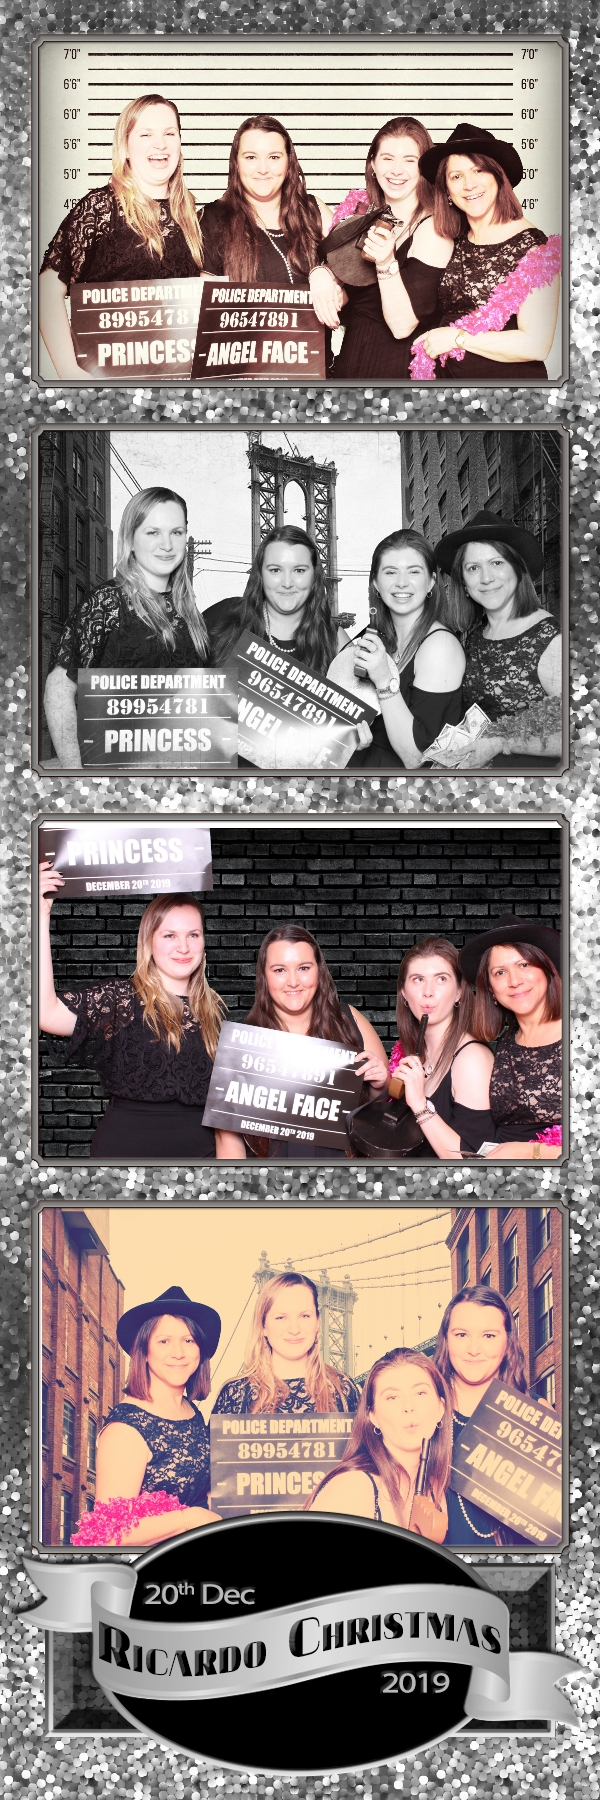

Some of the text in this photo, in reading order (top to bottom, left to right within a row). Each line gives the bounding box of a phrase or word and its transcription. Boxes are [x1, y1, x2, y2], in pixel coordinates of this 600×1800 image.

[82, 284, 203, 304] POLICE DEPARTME
[211, 288, 247, 303] POLICE
[220, 311, 298, 328] 96547891
[206, 340, 309, 367] ANGEL FACE
[90, 674, 226, 690] POLICE DEPARTMENT
[245, 641, 365, 720] POLICE DEPARTMENT
[106, 698, 208, 716] 89954781
[247, 670, 337, 731] 96547891
[104, 728, 212, 753] PRINCESS
[66, 837, 184, 866] PRINCESS
[85, 880, 130, 892] DECEMBER
[150, 878, 171, 889] 2019
[231, 1029, 274, 1049] POLICE
[224, 1080, 342, 1122] ANGEL FACE
[240, 1119, 280, 1135] DECEMBER
[295, 1130, 315, 1141] 2019
[494, 1389, 543, 1427] POLICE
[222, 1418, 353, 1435] POLICE DEPARTMENT
[237, 1441, 336, 1459] 89954781
[465, 1443, 536, 1500] ANGEL
[470, 1487, 512, 1520] DECEMBER
[525, 1523, 548, 1542] 2019
